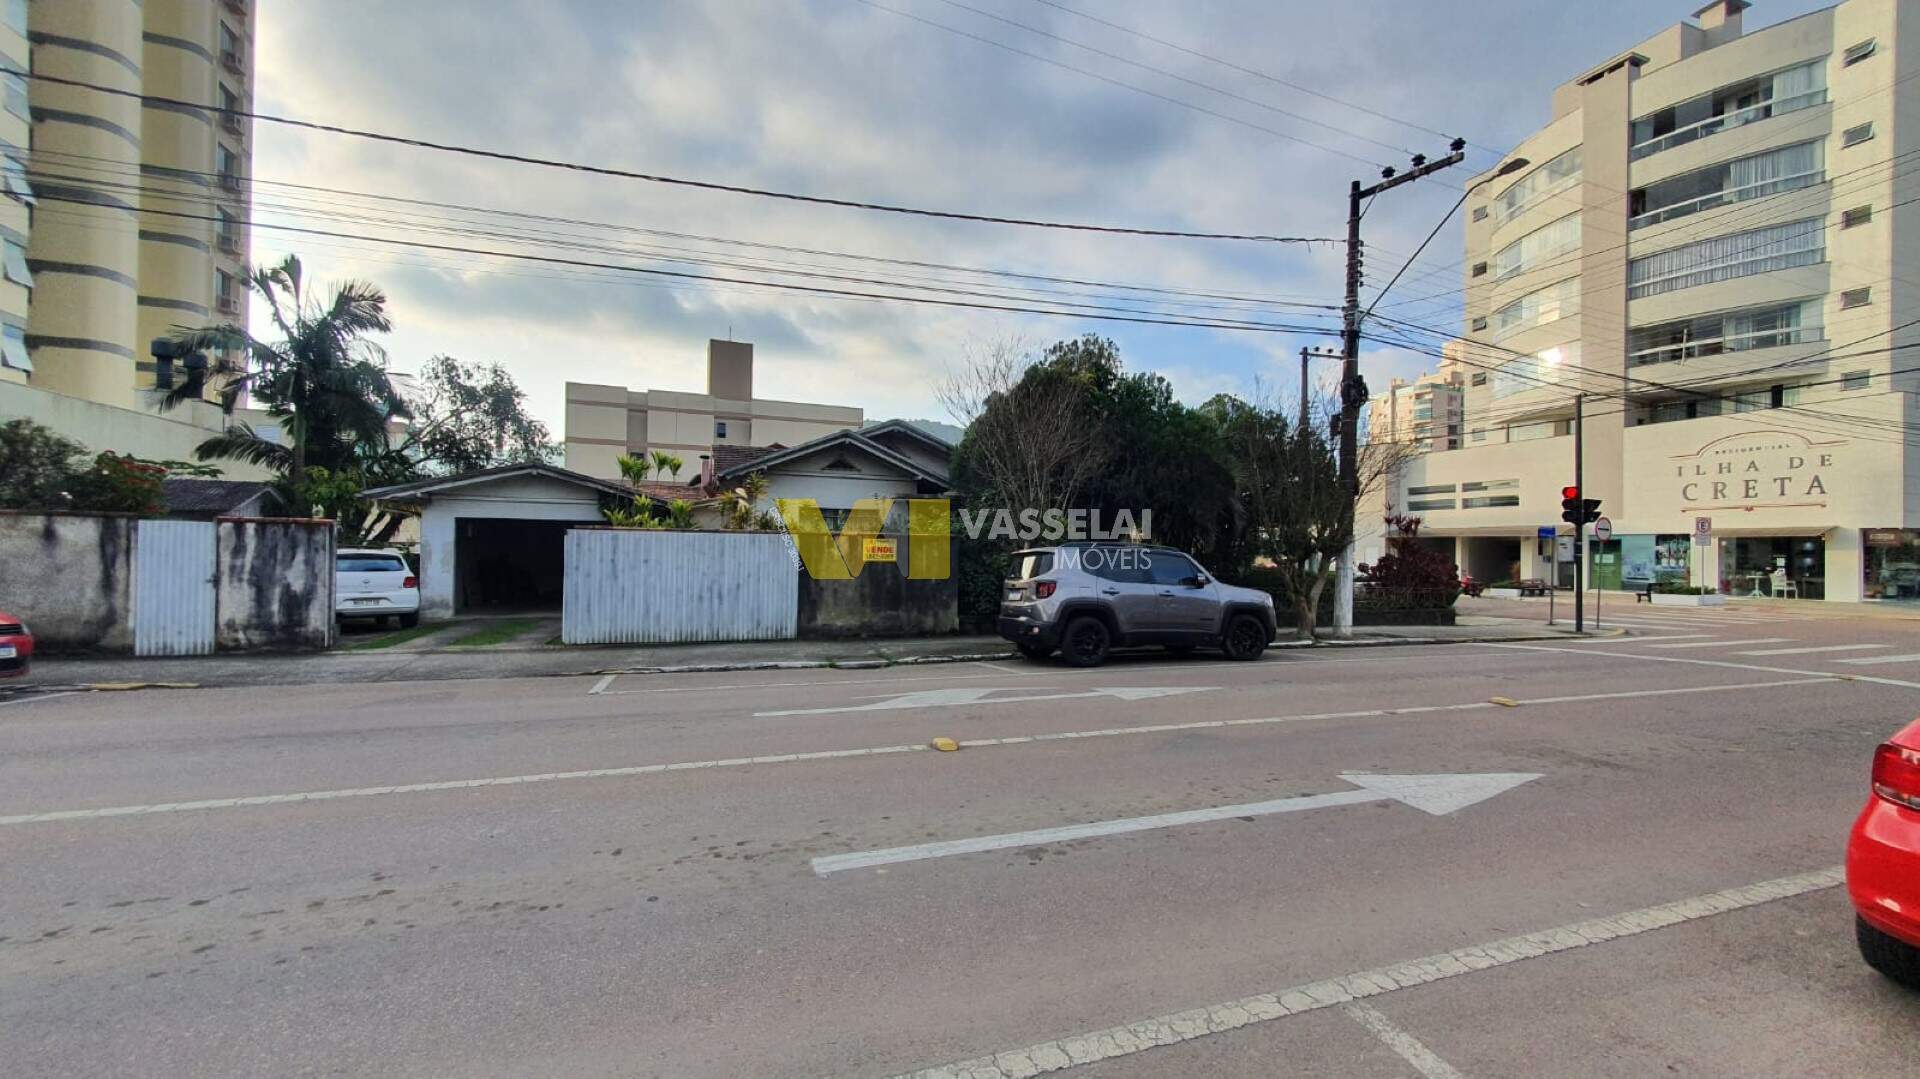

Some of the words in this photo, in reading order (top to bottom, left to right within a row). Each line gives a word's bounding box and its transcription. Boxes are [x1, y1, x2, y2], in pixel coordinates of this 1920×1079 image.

[1677, 460, 1760, 477] ILHA
[1789, 454, 1833, 470] DE
[1682, 474, 1827, 501] CRETA
